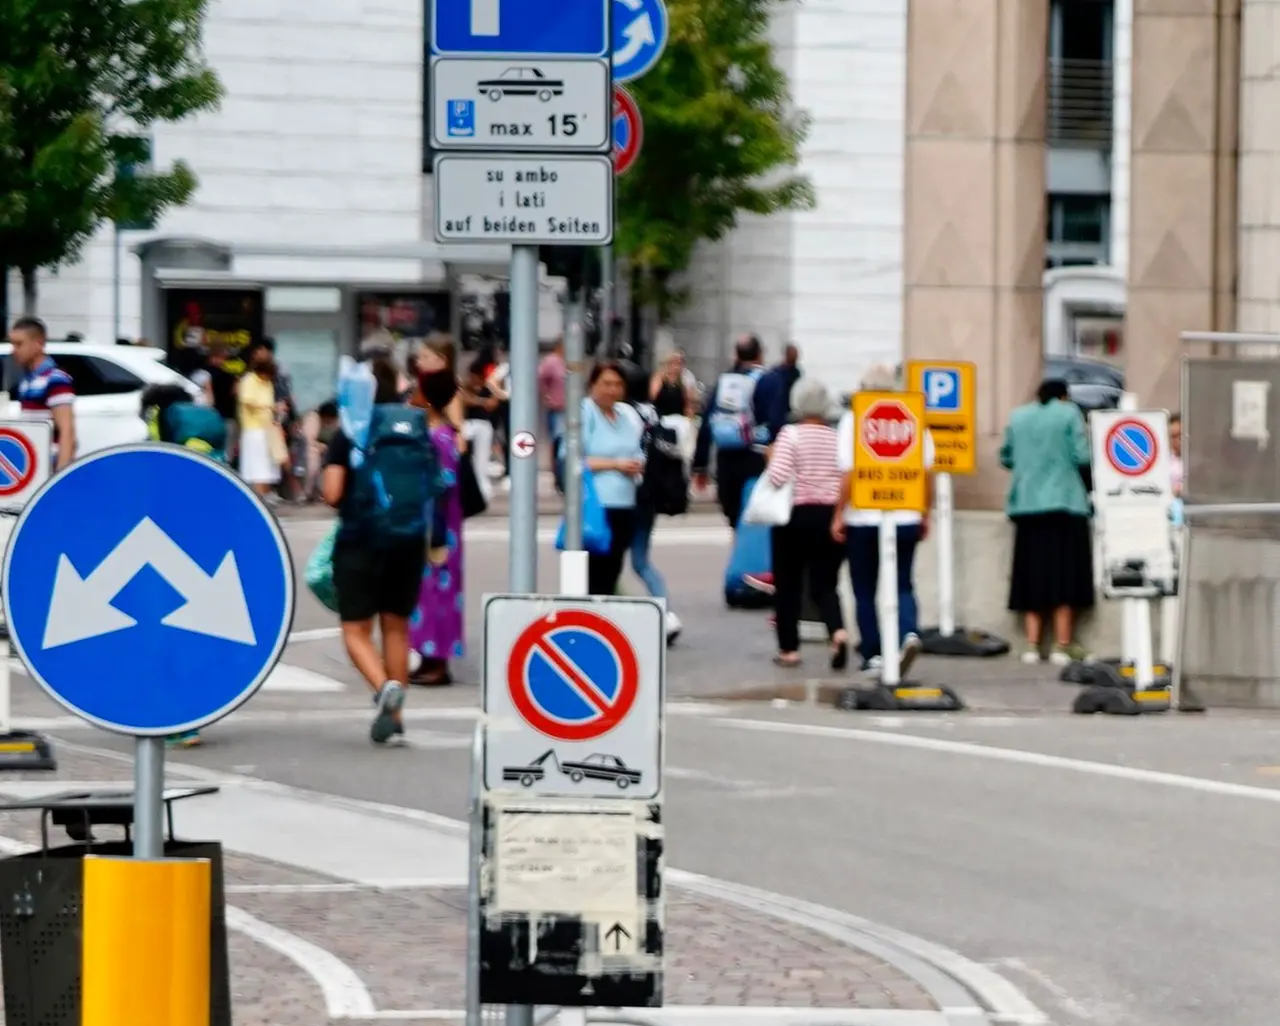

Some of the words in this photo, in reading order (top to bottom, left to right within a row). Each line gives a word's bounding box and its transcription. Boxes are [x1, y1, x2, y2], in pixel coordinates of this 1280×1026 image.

[490, 123, 533, 136] max
[487, 170, 504, 183] su
[515, 166, 559, 183] ambo
[499, 191, 504, 207] i
[516, 191, 545, 208] lati
[445, 216, 472, 232] auf
[484, 216, 536, 233] beiden
[548, 217, 600, 234] Seiten
[927, 372, 955, 406] P
[866, 418, 914, 444] STOP
